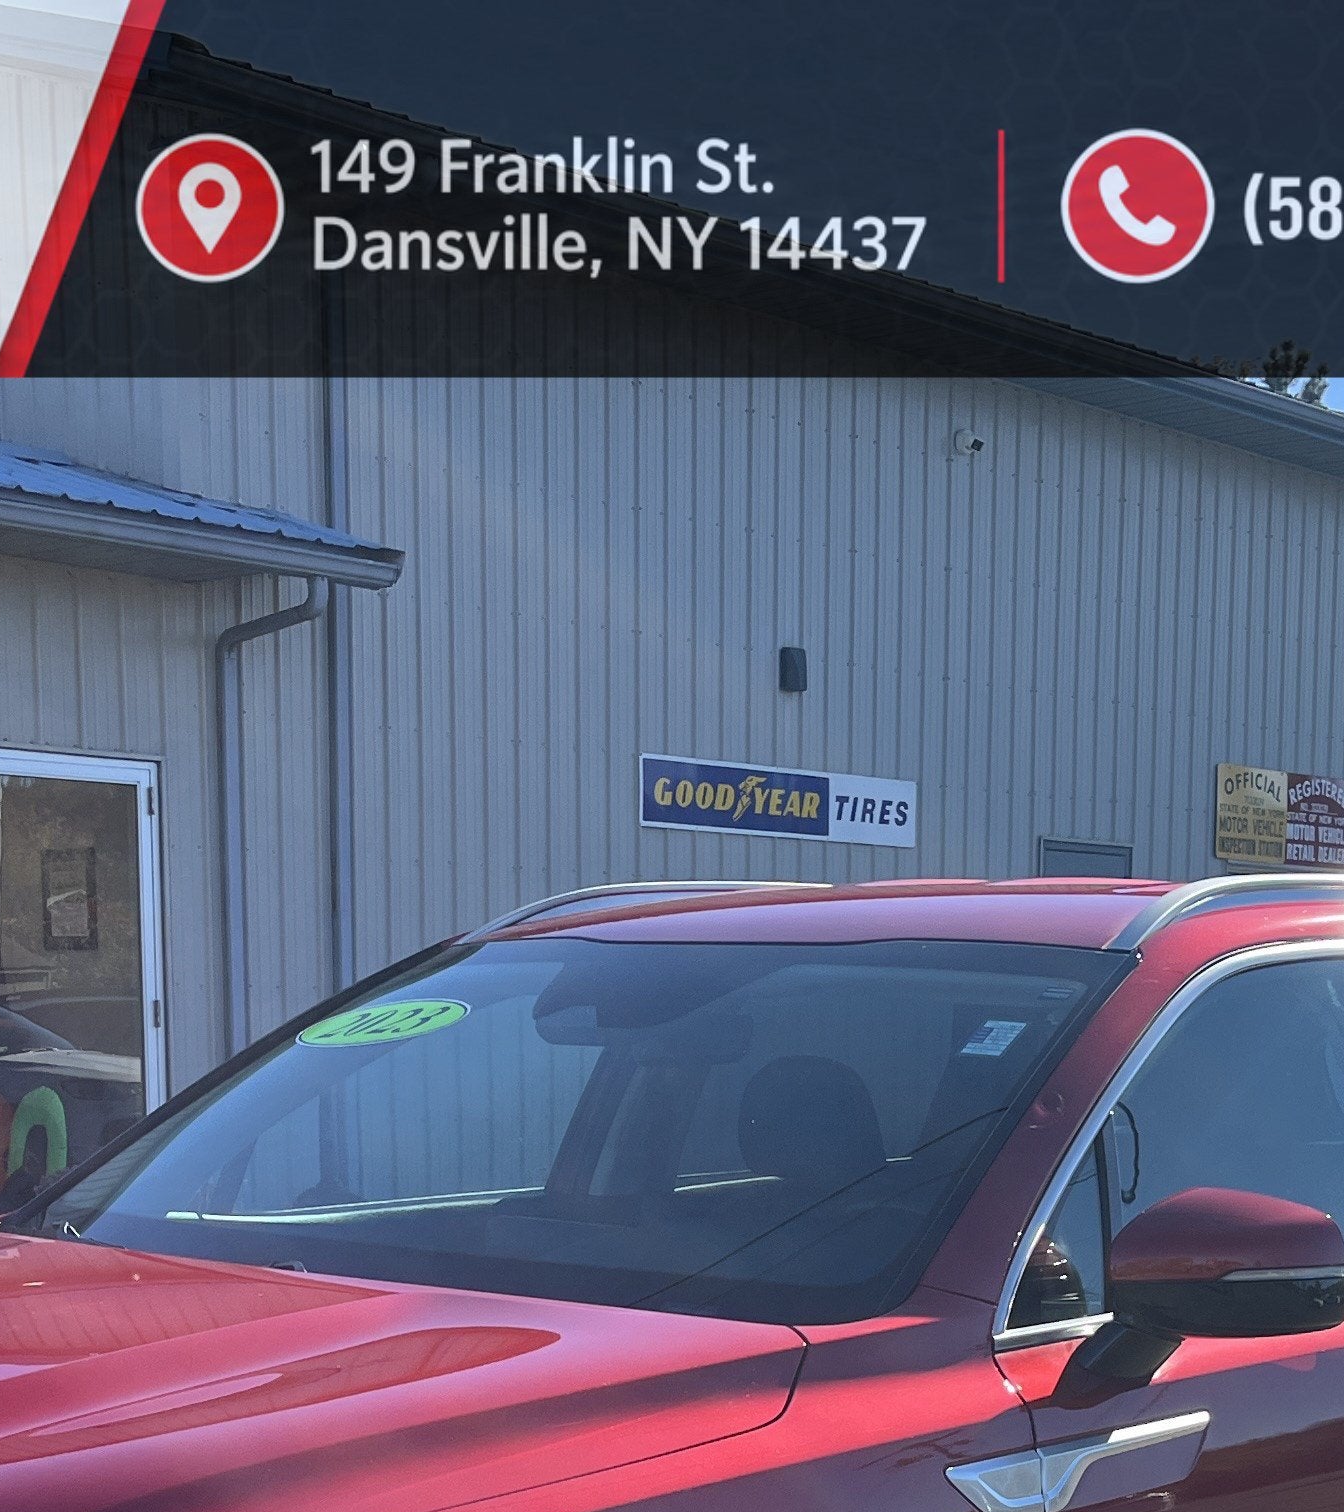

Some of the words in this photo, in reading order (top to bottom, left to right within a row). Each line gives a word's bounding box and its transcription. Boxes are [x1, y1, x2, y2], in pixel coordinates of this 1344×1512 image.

[1224, 771, 1282, 803] OFFICIAL
[834, 795, 909, 827] TIRES
[1219, 803, 1239, 813] STATE
[1241, 805, 1250, 815] OF
[1253, 807, 1266, 816] NEW
[1287, 812, 1307, 823] STATE
[1309, 813, 1318, 823] OF
[1319, 815, 1332, 825] NEW
[1219, 815, 1248, 834] MOTOR
[1253, 818, 1285, 838] VEHICLE
[1286, 822, 1316, 842] MOTOR
[1286, 843, 1316, 862] RETAIL
[315, 1006, 451, 1040] 2023
